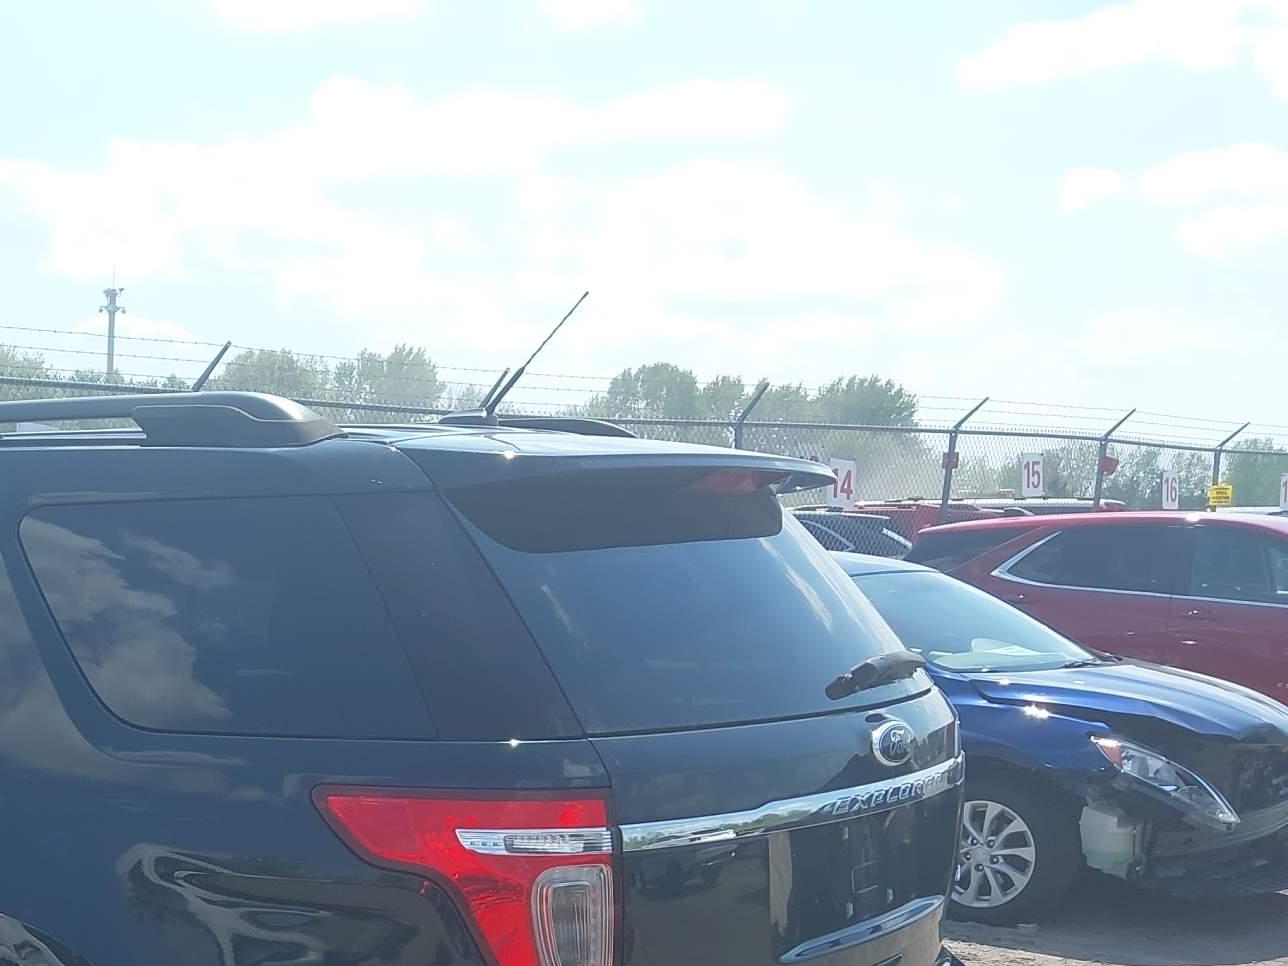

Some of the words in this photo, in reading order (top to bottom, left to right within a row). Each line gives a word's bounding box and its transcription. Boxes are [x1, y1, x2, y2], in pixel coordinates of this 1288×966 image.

[831, 467, 854, 500] 14
[1023, 460, 1041, 489] 15
[1164, 477, 1178, 502] 16
